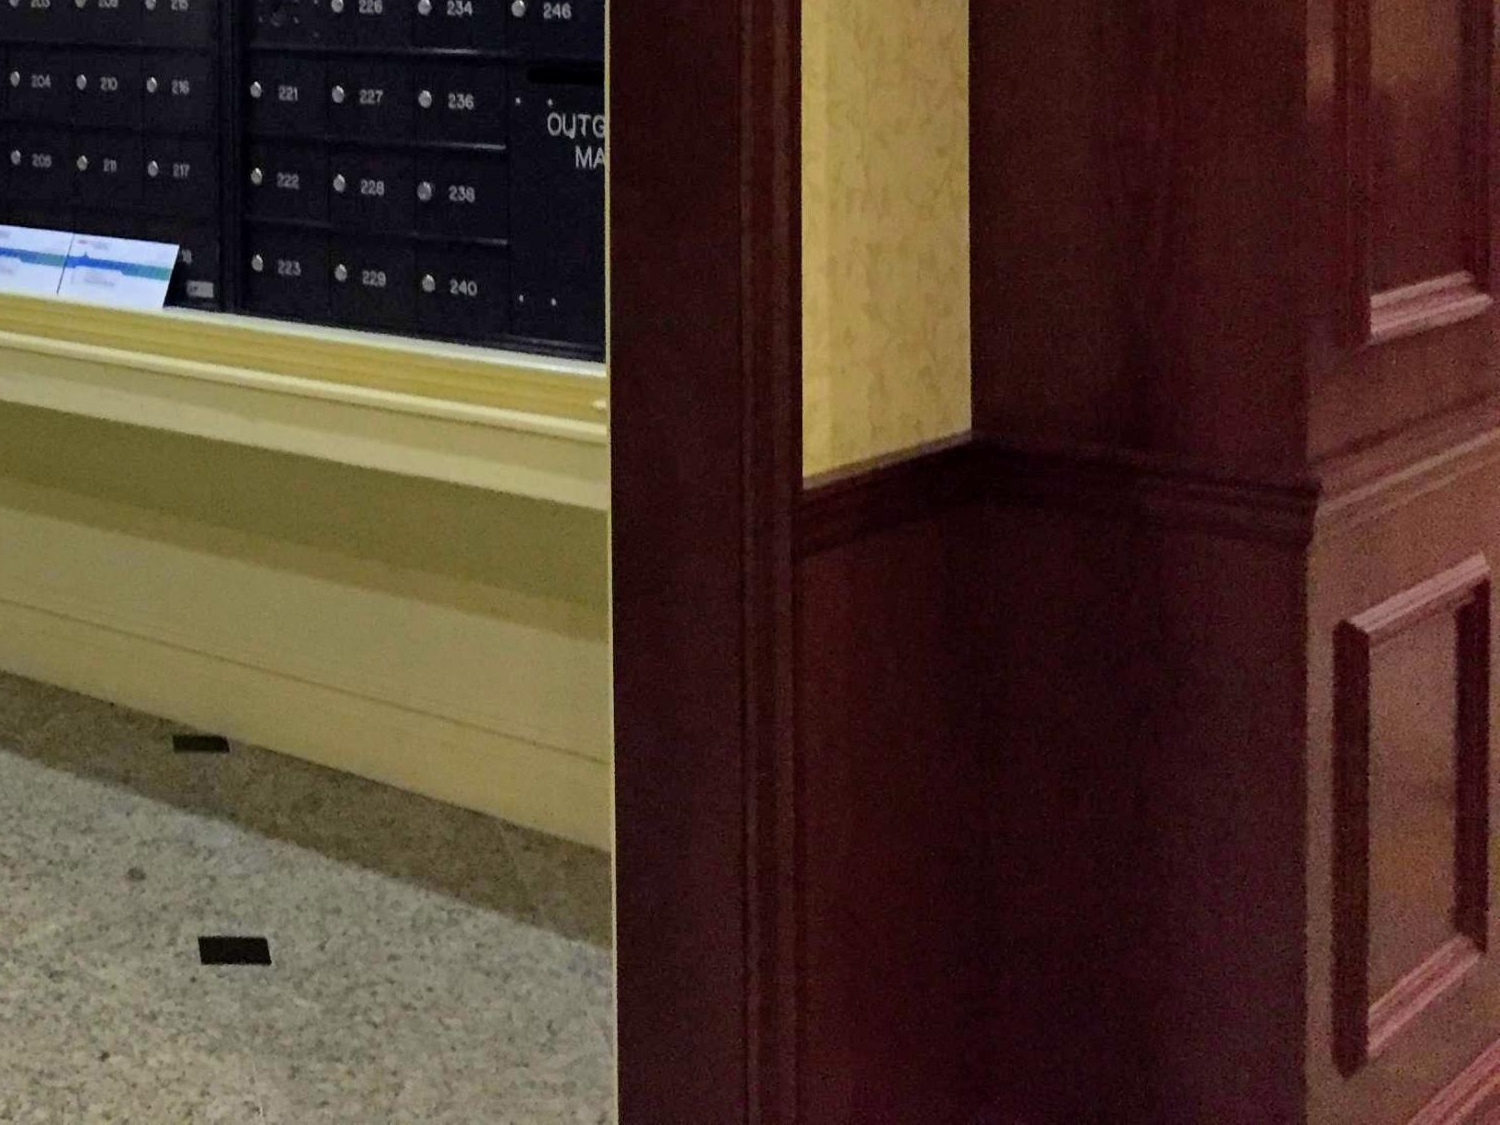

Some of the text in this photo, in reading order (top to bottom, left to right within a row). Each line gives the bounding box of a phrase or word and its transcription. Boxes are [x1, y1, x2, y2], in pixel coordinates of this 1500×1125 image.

[446, 0, 474, 17] 234
[543, 2, 572, 20] 246
[278, 84, 299, 102] 221
[359, 88, 384, 105] 227
[447, 92, 475, 110] 236
[547, 111, 605, 139] OUTG
[575, 145, 605, 170] MA
[276, 171, 300, 190] 222
[448, 184, 476, 204] 238
[277, 259, 302, 276] 223
[449, 278, 478, 297] 240
